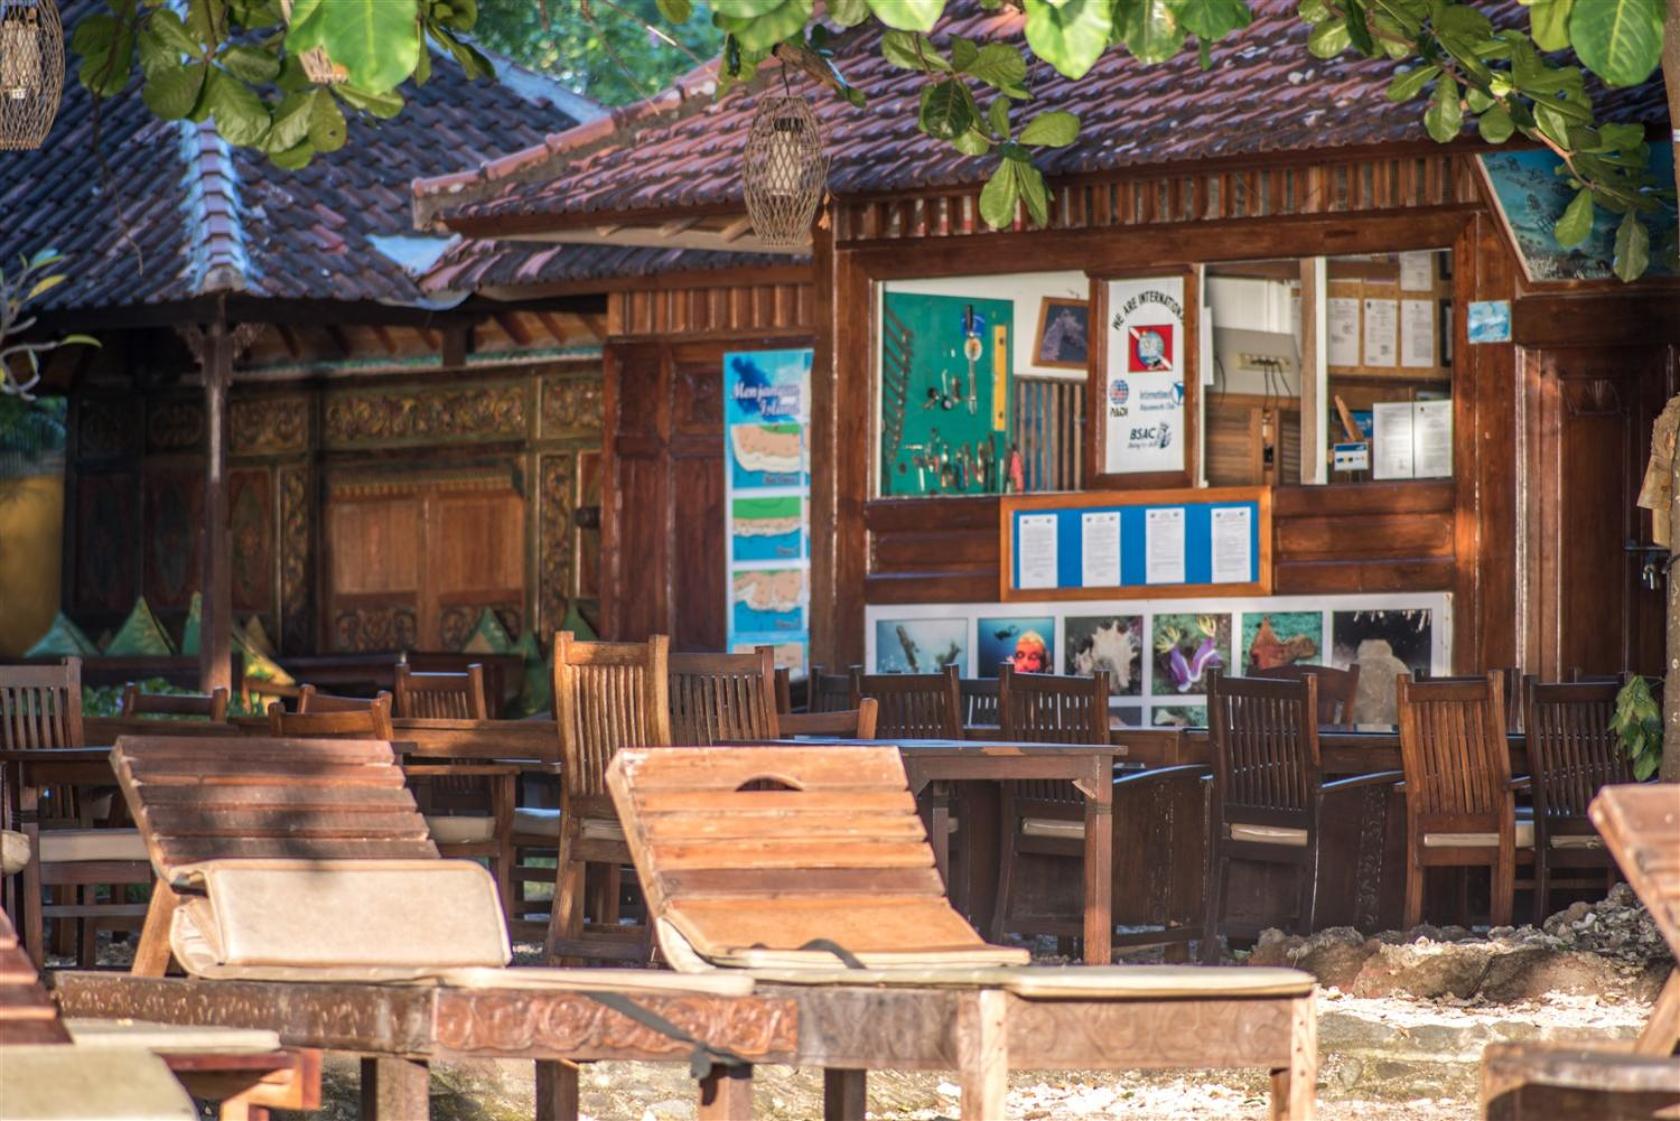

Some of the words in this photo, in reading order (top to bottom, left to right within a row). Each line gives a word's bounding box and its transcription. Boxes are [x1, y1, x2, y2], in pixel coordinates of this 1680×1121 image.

[1112, 313, 1124, 331] WE
[1123, 297, 1138, 315] ARE
[1130, 428, 1156, 440] BSAC
